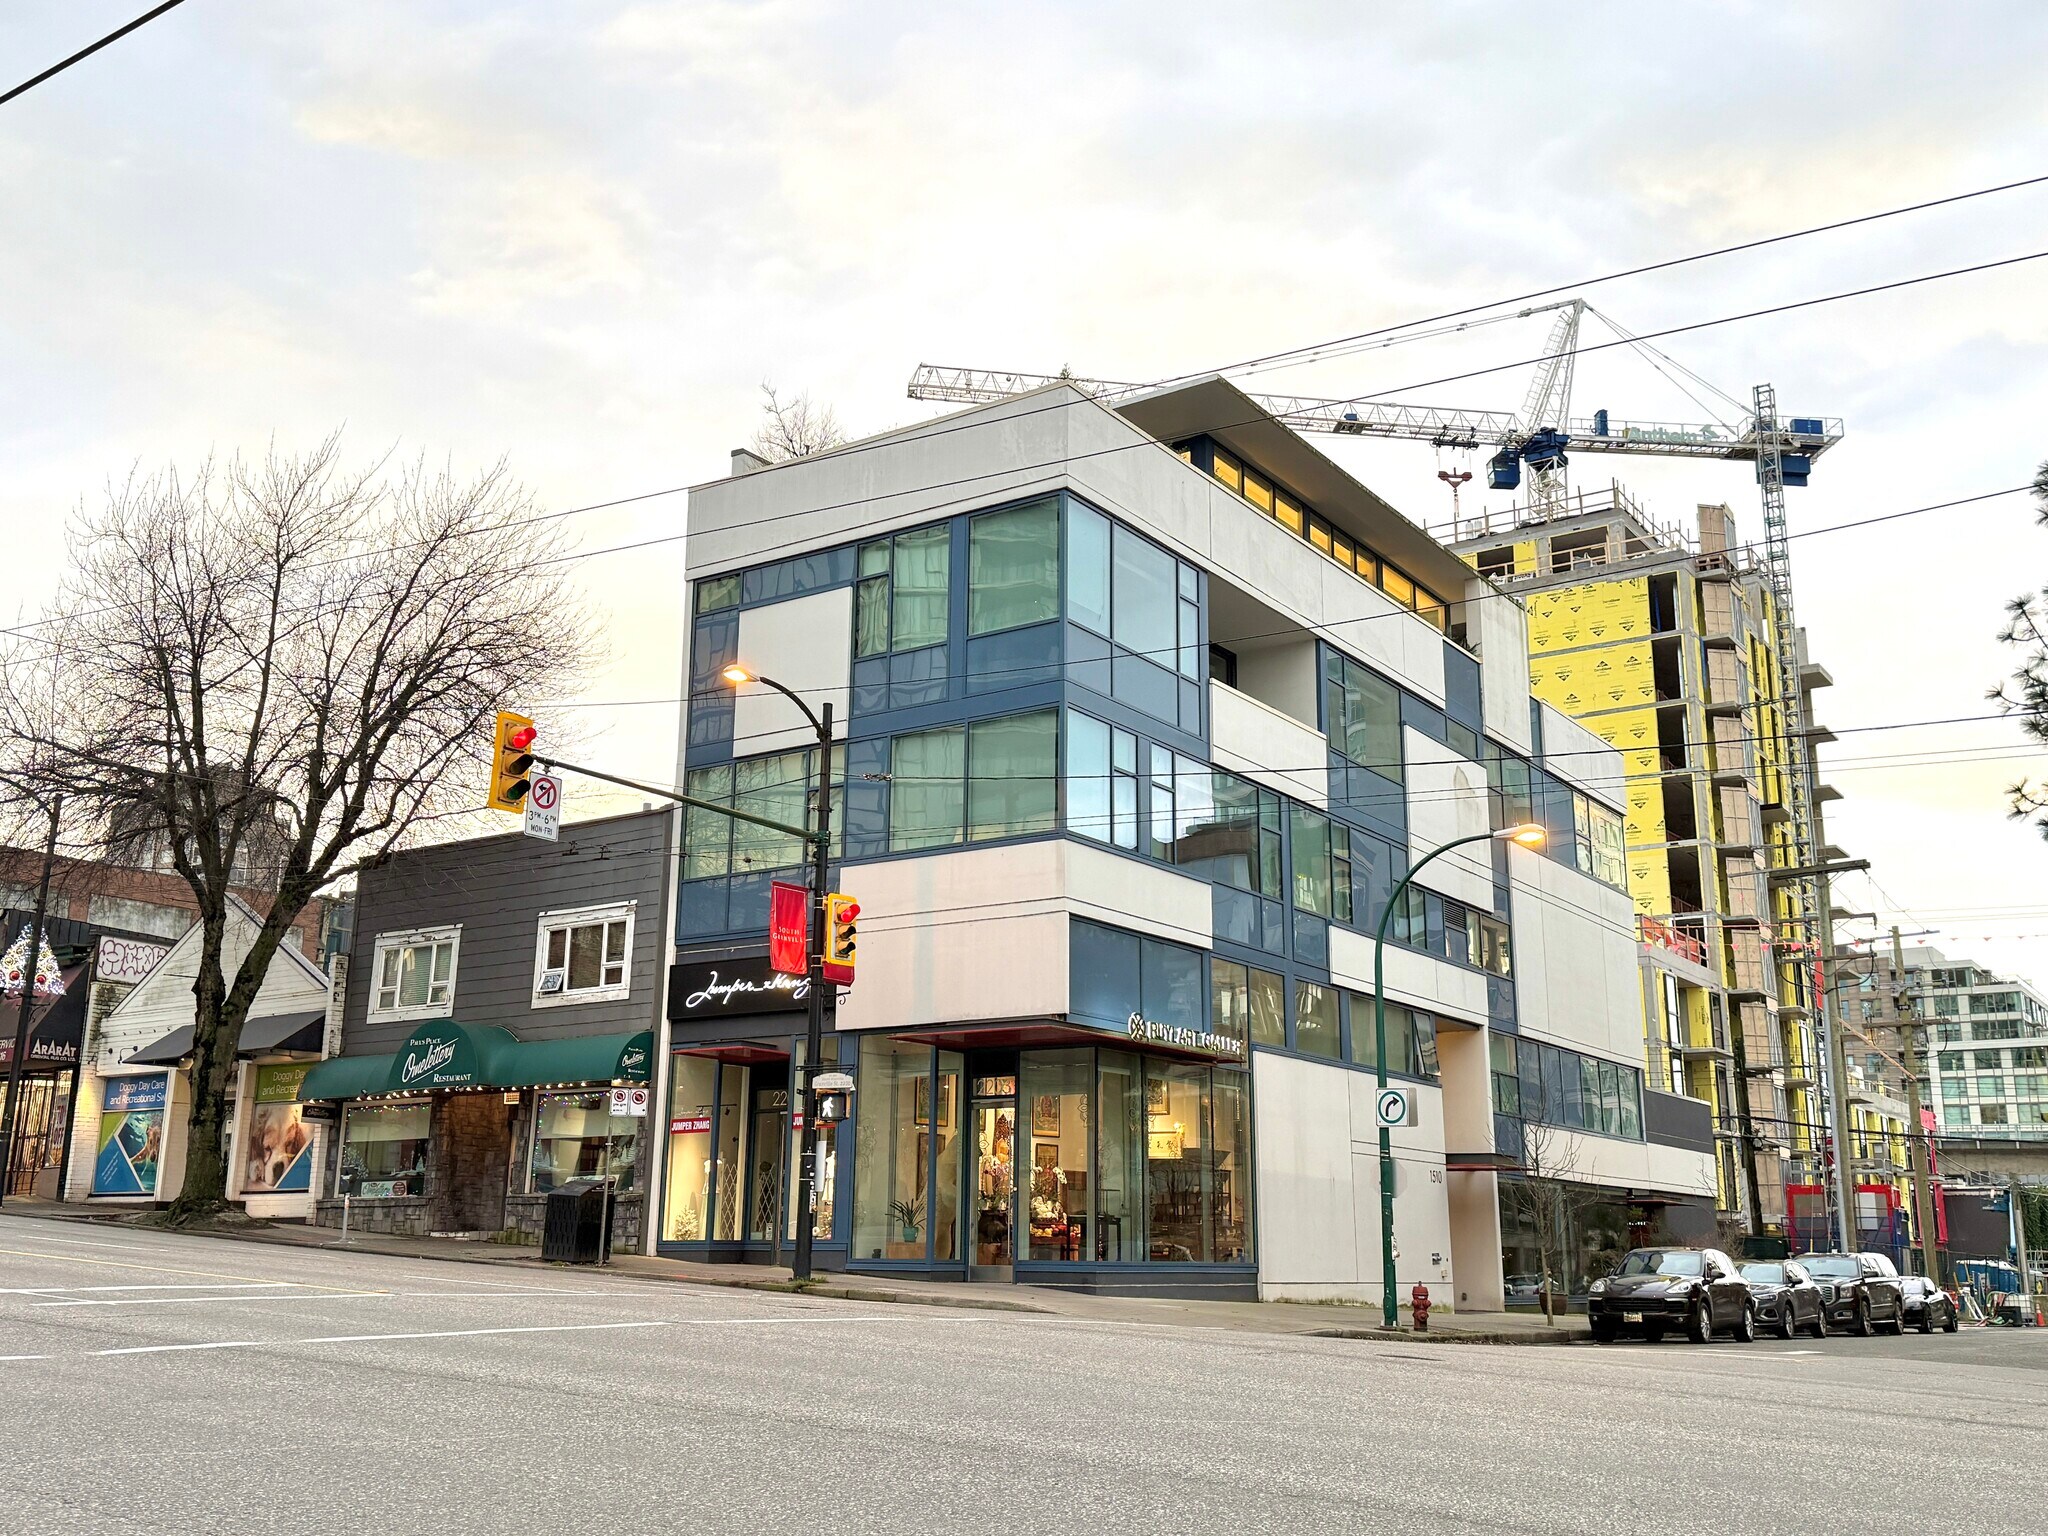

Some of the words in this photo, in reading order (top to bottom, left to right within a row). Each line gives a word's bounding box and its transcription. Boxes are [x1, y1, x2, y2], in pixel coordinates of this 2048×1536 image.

[272, 1071, 294, 1083] Doggy
[433, 1073, 472, 1083] RESTAURANT
[119, 1082, 138, 1093] Doggy
[138, 1081, 150, 1092] Day
[151, 1080, 165, 1090] Care
[262, 1085, 275, 1096] and
[109, 1095, 121, 1105] and
[121, 1093, 156, 1104] Recreational
[671, 1121, 693, 1132] JUMPER
[692, 1119, 710, 1131] ZHANG
